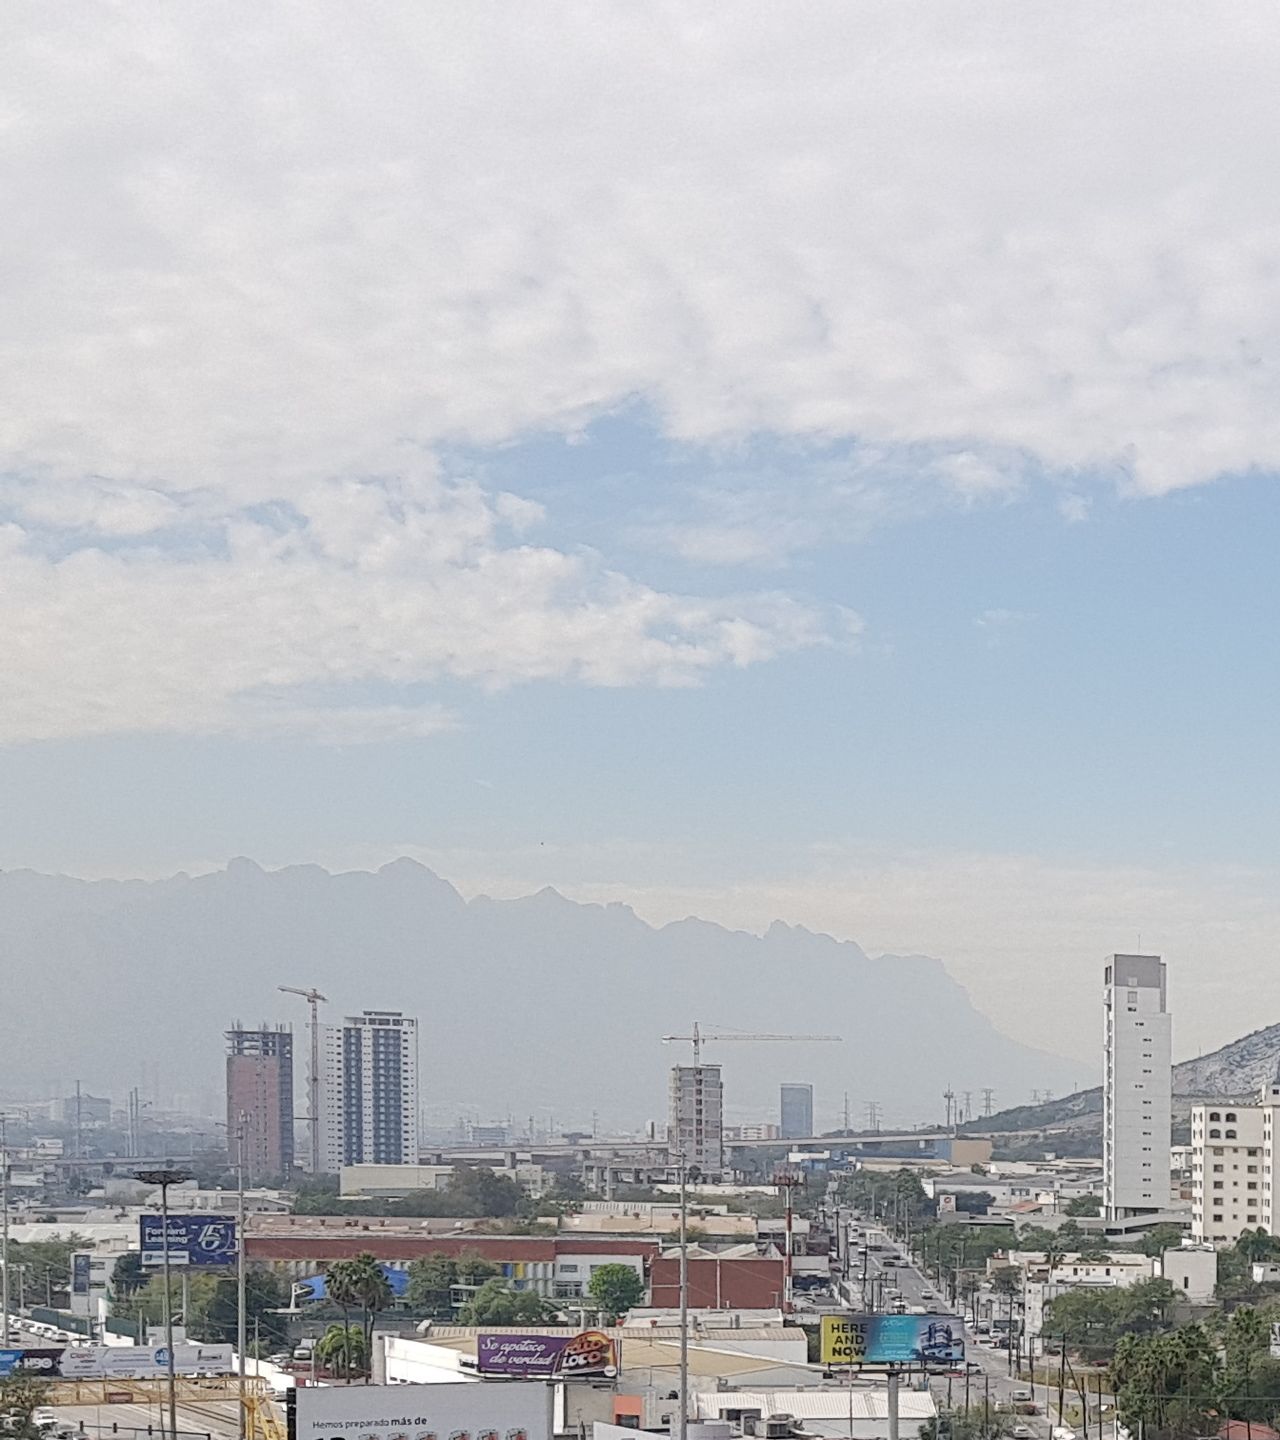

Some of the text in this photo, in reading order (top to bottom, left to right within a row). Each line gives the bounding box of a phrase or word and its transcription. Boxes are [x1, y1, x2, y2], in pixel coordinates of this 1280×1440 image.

[145, 1235, 188, 1244] Leaning
[831, 1323, 868, 1334] HERE
[481, 1337, 499, 1351] Se
[834, 1335, 865, 1345] AND
[831, 1346, 868, 1357] NOW
[489, 1351, 556, 1366] de verdad
[312, 1416, 428, 1430] Hemos preparado más de
